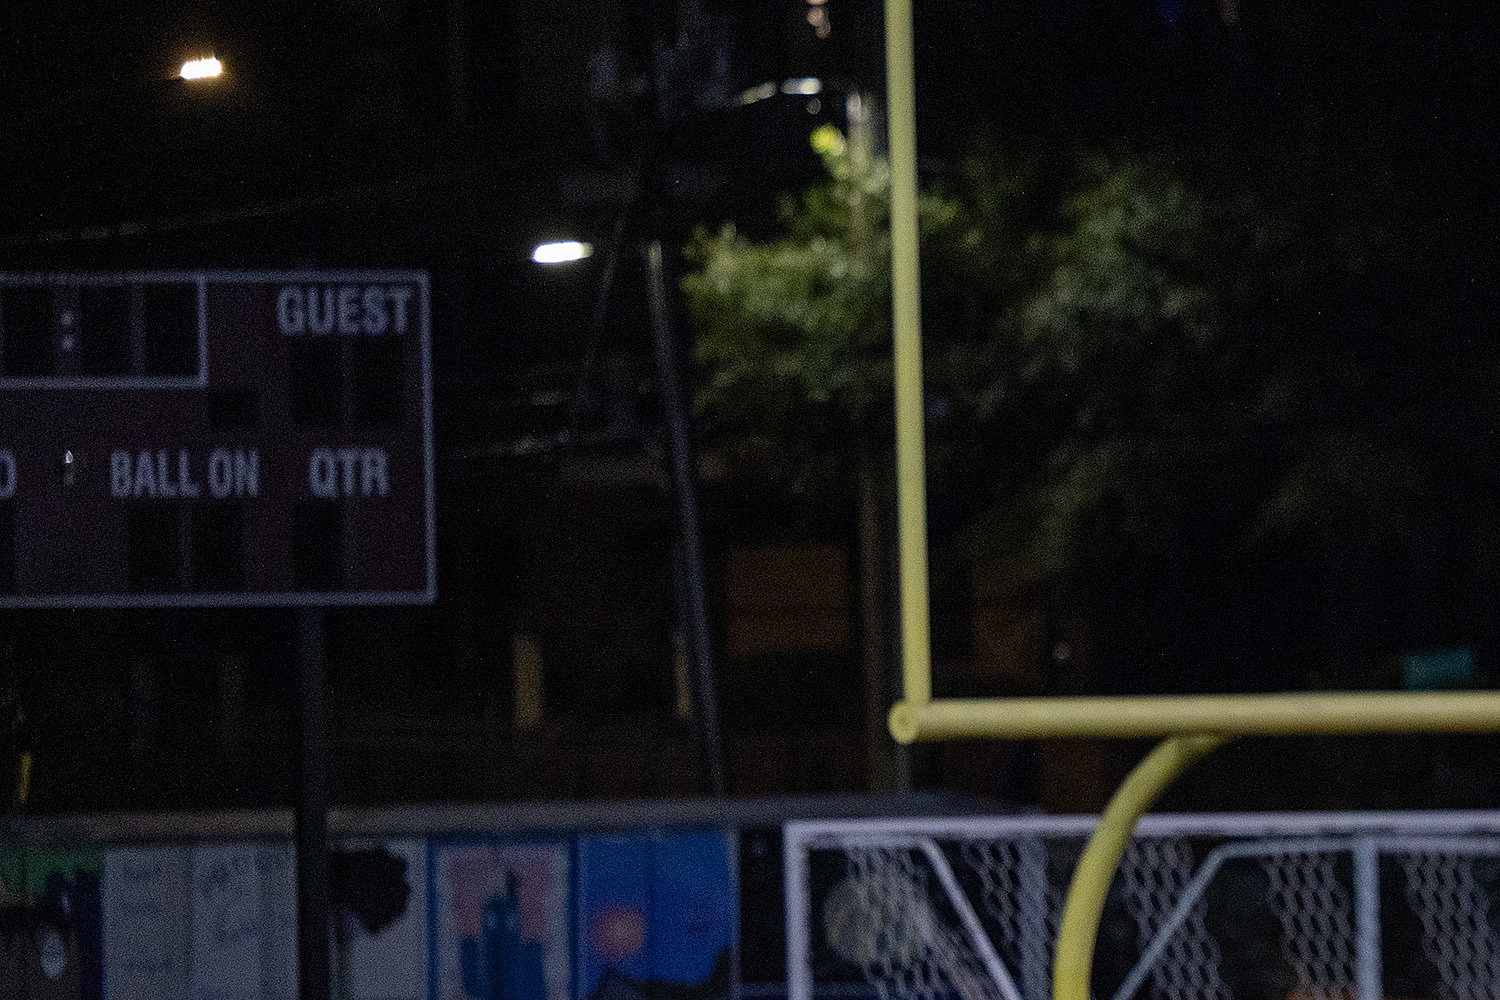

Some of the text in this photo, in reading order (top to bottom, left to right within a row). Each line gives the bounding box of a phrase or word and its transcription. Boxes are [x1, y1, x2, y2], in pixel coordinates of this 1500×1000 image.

[277, 285, 413, 336] GUEST
[109, 447, 260, 499] BALL ON
[308, 447, 390, 499] QTR
